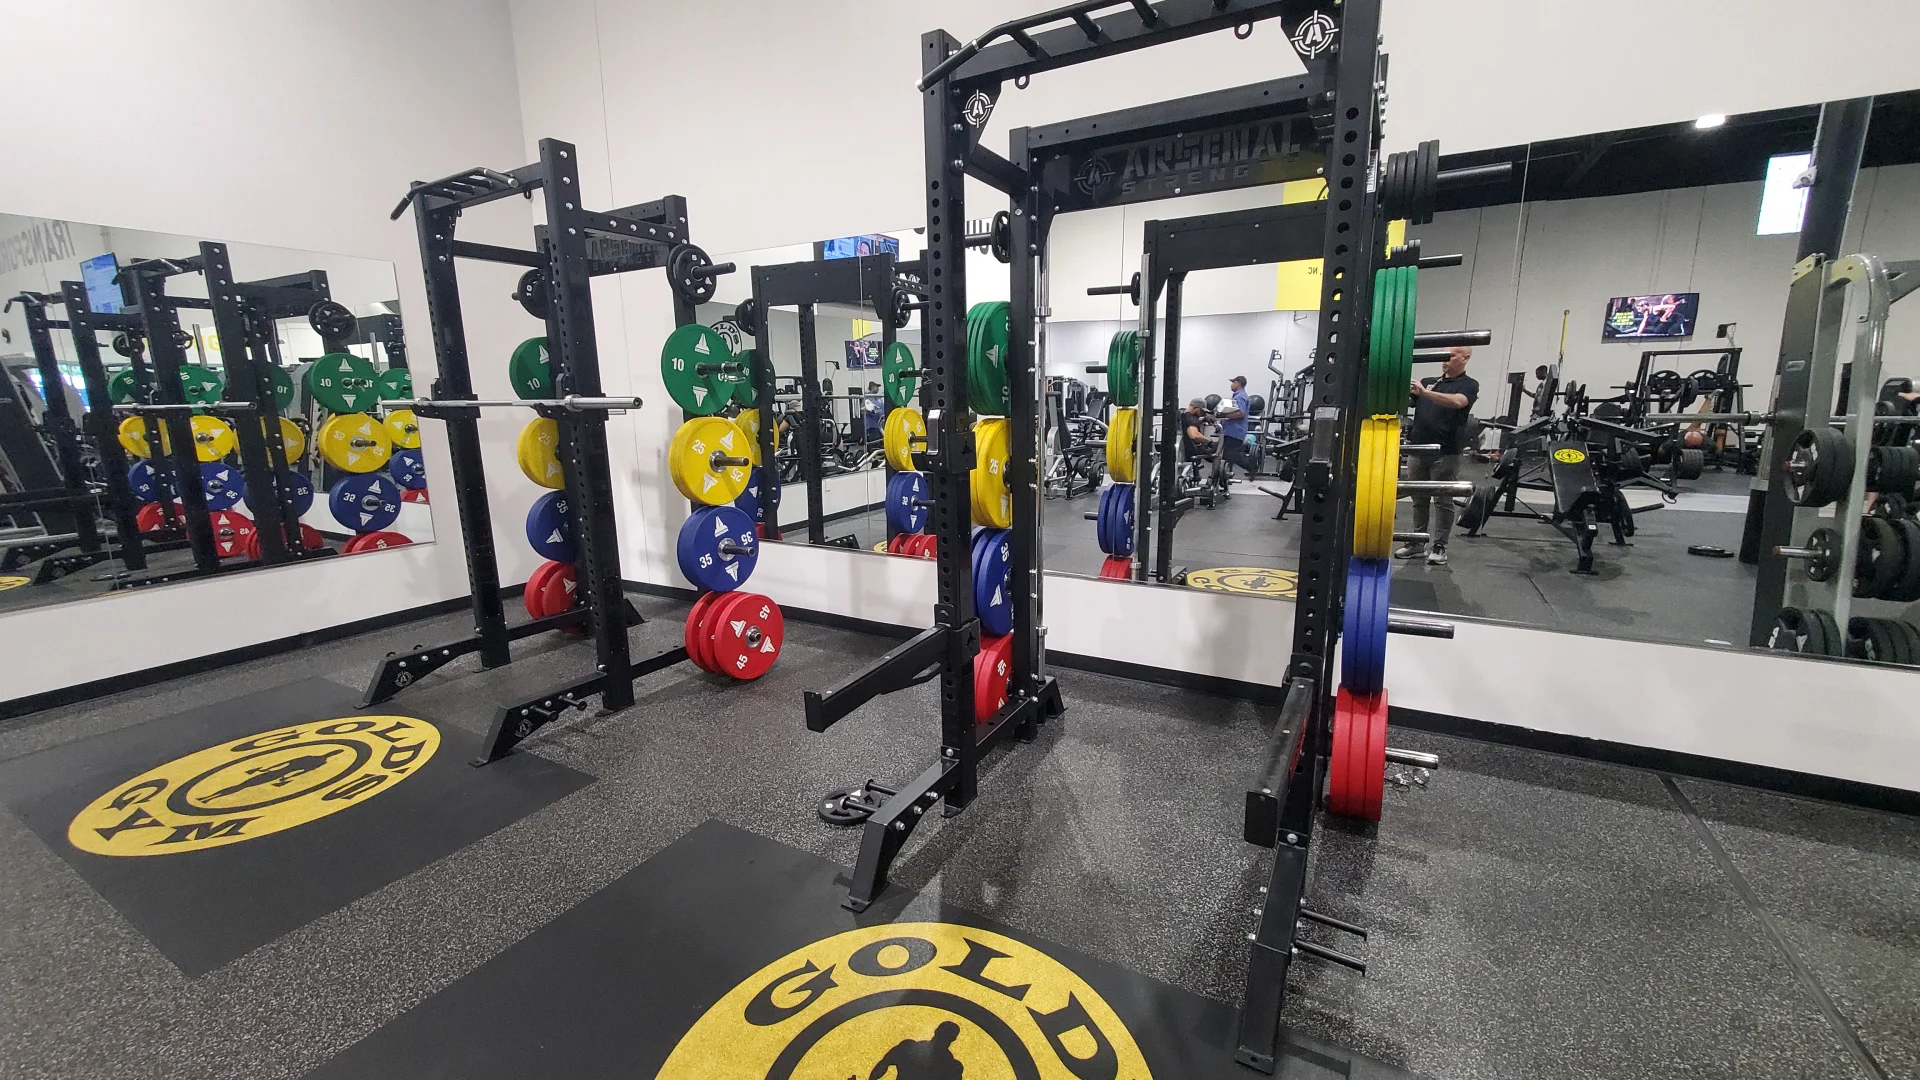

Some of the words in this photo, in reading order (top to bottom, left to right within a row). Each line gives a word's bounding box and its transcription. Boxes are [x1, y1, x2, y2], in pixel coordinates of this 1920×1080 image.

[1122, 120, 1301, 182] ARSENAL
[525, 284, 533, 297] 10
[671, 356, 685, 372] 10
[526, 377, 541, 391] 10
[1001, 385, 1011, 404] 10
[538, 432, 551, 446] 25
[691, 438, 707, 455] 25
[989, 457, 999, 475] 25
[729, 467, 744, 483] 25
[556, 499, 569, 514] 35
[741, 531, 754, 546] 35
[699, 552, 713, 569] 35
[1000, 542, 1010, 562] 35
[758, 604, 771, 620] 45
[735, 653, 749, 670] 45
[997, 659, 1007, 677] 45
[230, 720, 427, 802] GOLD'S
[94, 778, 265, 847] GYM
